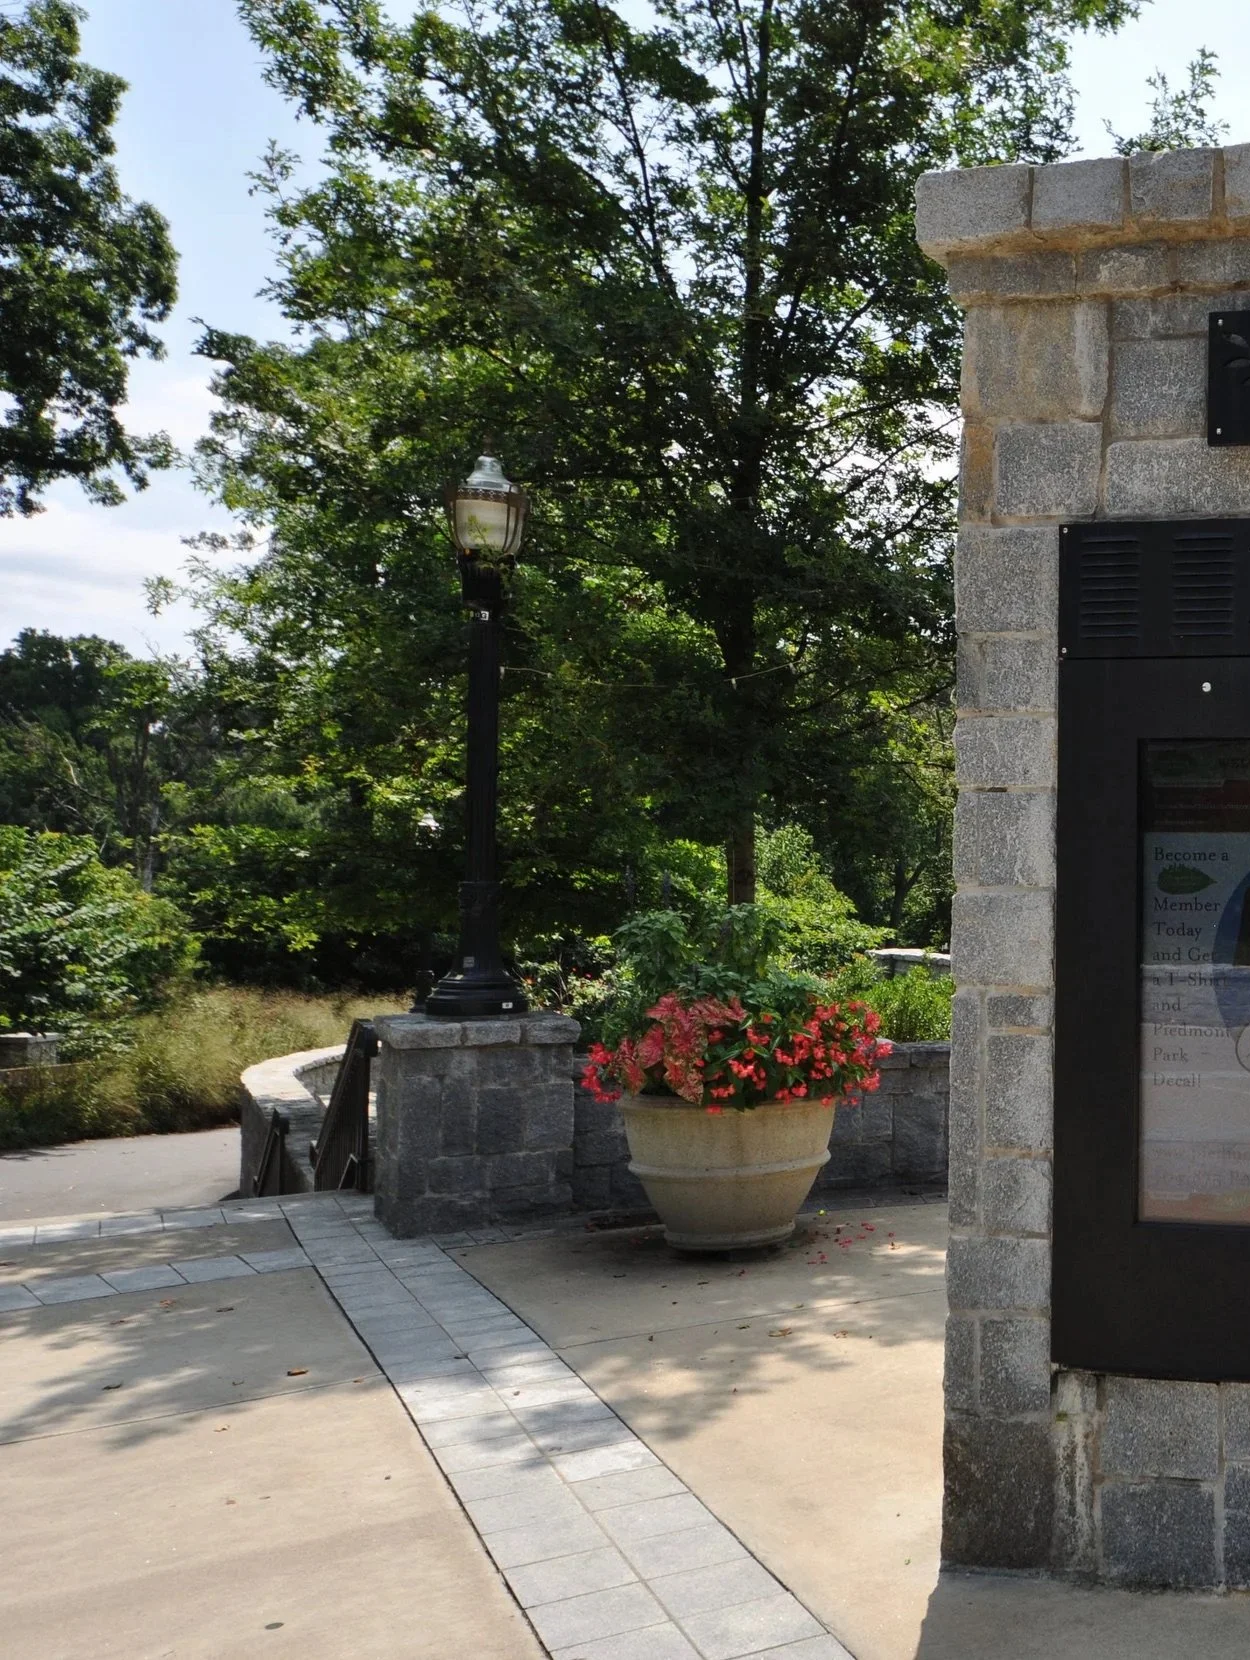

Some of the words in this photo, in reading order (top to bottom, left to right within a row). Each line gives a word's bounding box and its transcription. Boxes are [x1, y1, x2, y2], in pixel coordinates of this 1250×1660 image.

[1153, 847, 1216, 862] Become
[1218, 852, 1230, 862] a
[1153, 896, 1221, 912] Member
[1154, 920, 1202, 942] Today
[1152, 946, 1181, 962] and
[1187, 947, 1218, 962] Get
[1152, 976, 1162, 987] a
[1166, 971, 1230, 987] T-Shirt
[1152, 997, 1182, 1012] and
[1152, 1021, 1231, 1038] Piedmont
[1152, 1047, 1189, 1063] Park
[1152, 1072, 1202, 1088] Decal!
